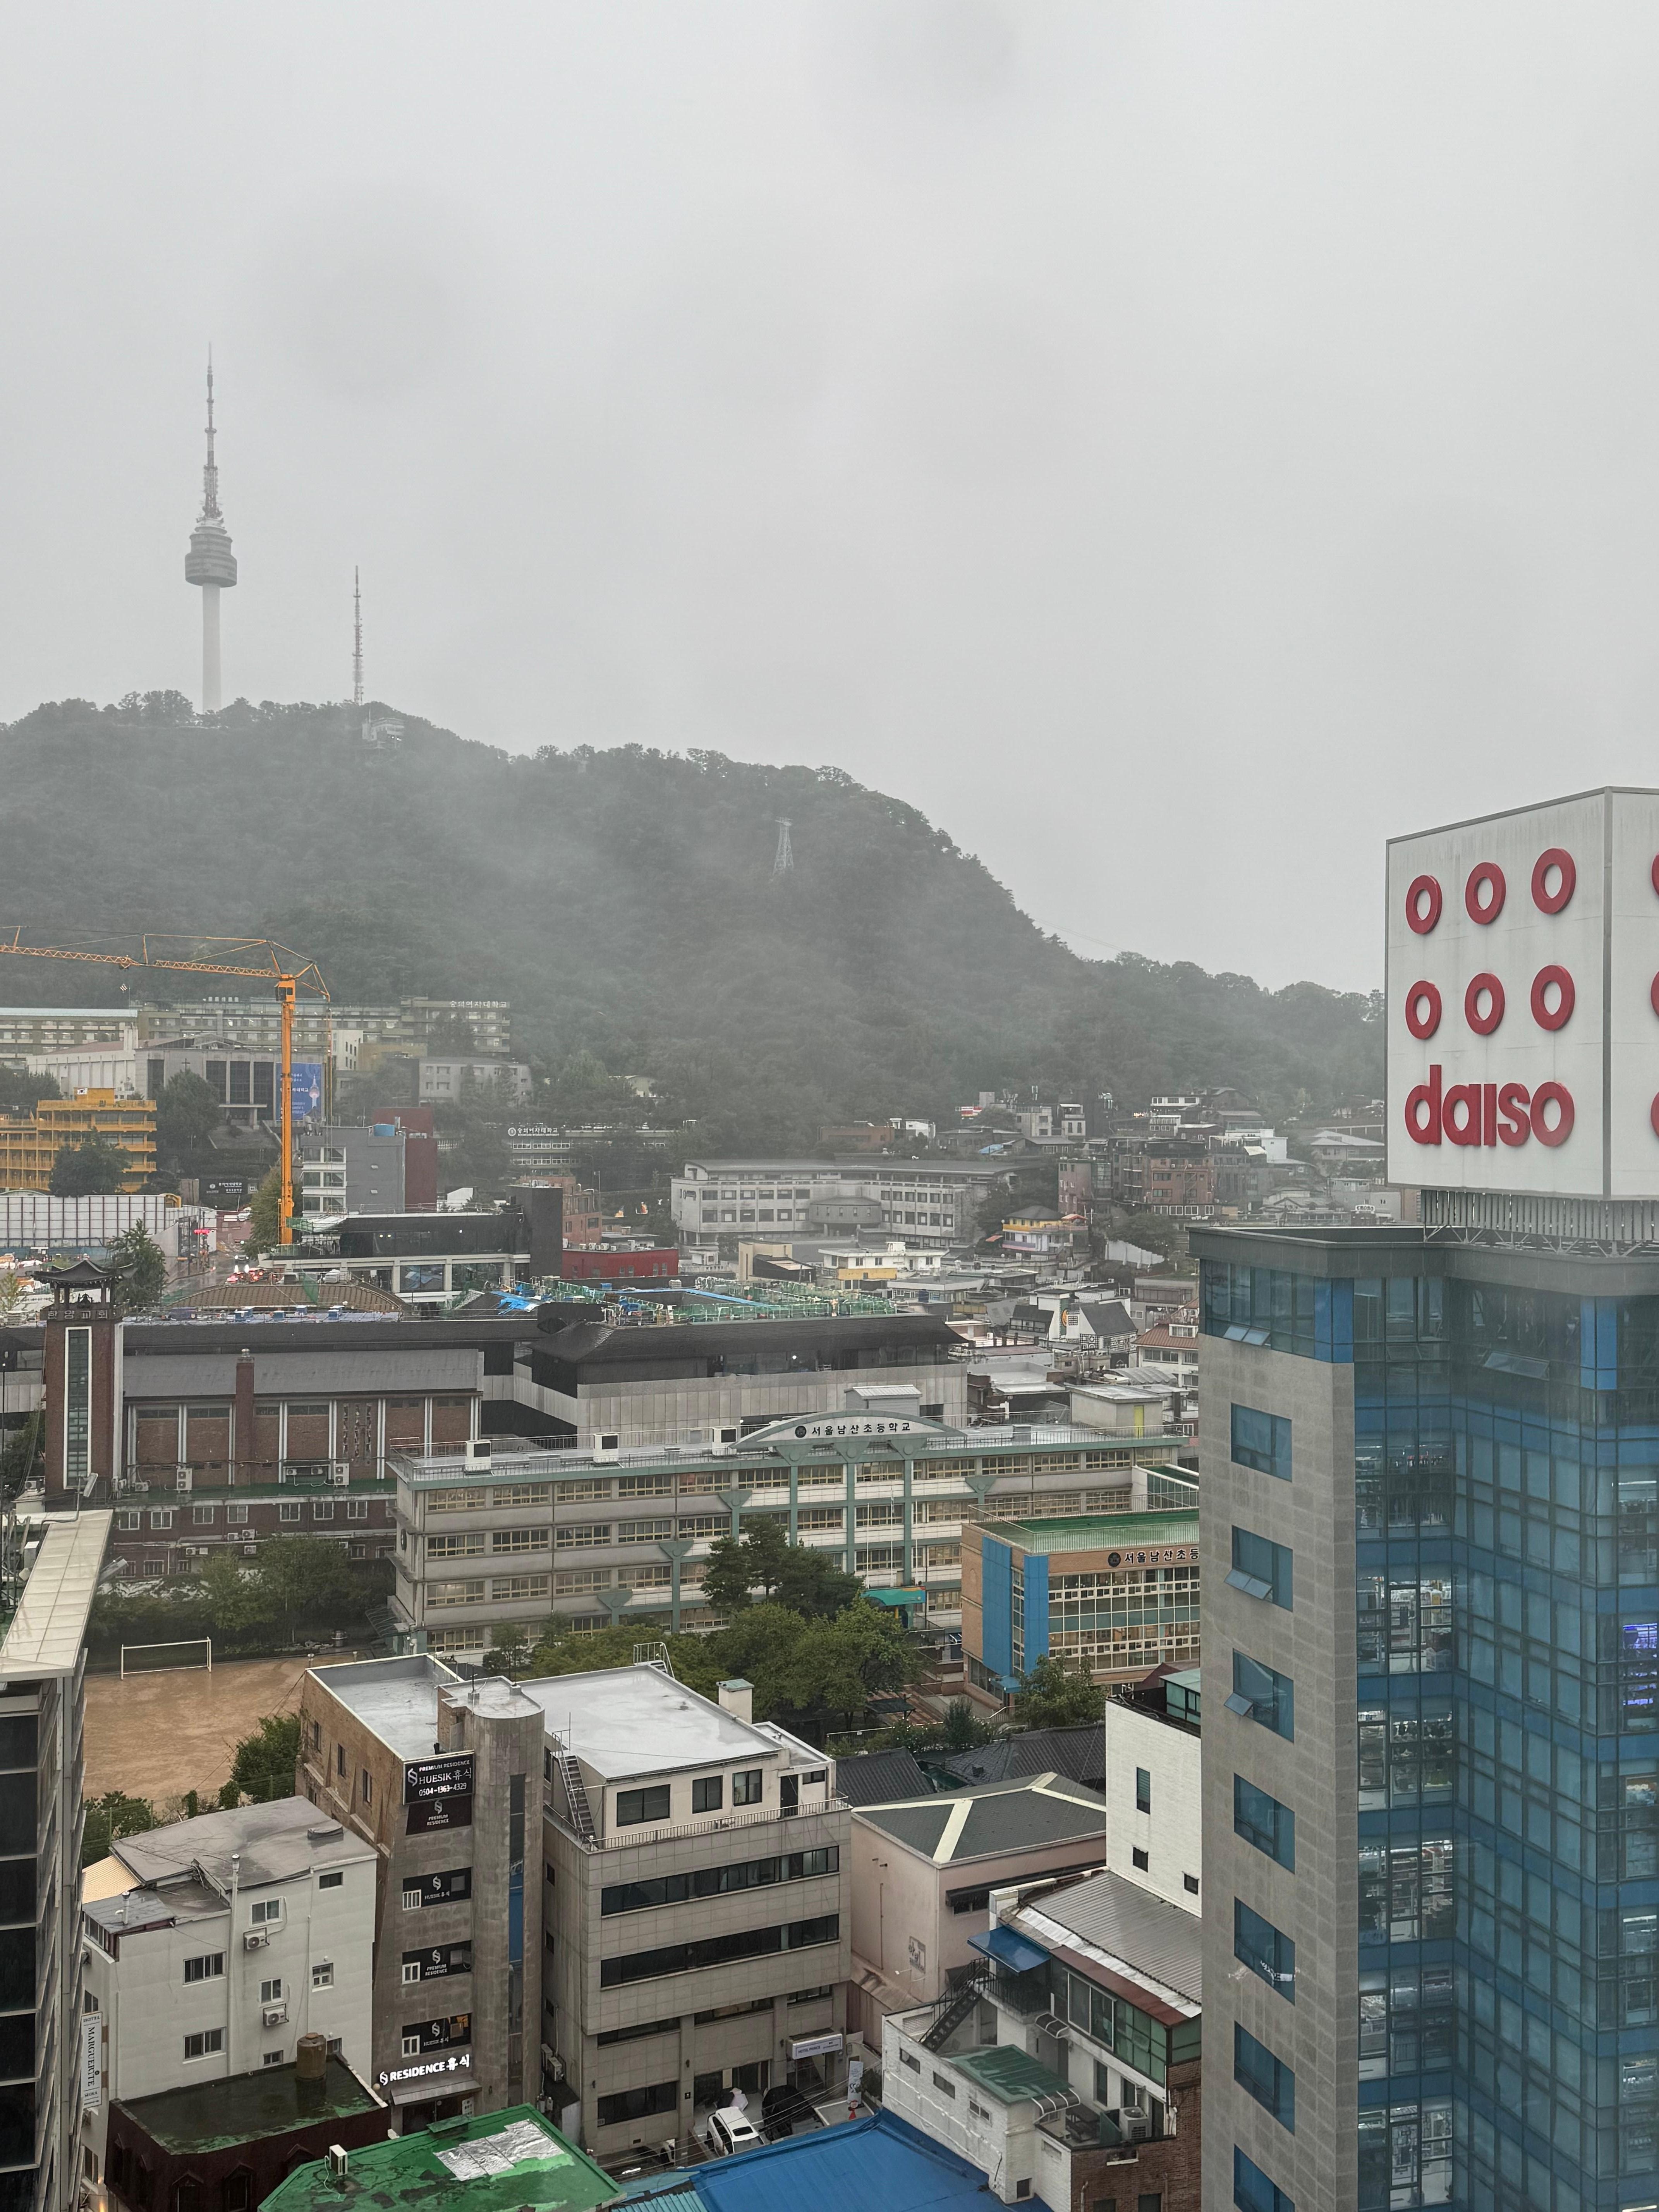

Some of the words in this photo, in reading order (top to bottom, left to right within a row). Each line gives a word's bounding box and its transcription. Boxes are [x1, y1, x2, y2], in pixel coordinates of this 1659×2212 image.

[1405, 1064, 1575, 1147] daiso
[812, 1423, 910, 1436] 서울남산초등학교
[419, 1764, 442, 1772] PREMIUM
[443, 1760, 470, 1768] RESIDENCE
[419, 1772, 452, 1785] HUESIK
[452, 1767, 472, 1781] 휴식
[390, 2061, 445, 2081] RESIDENCE
